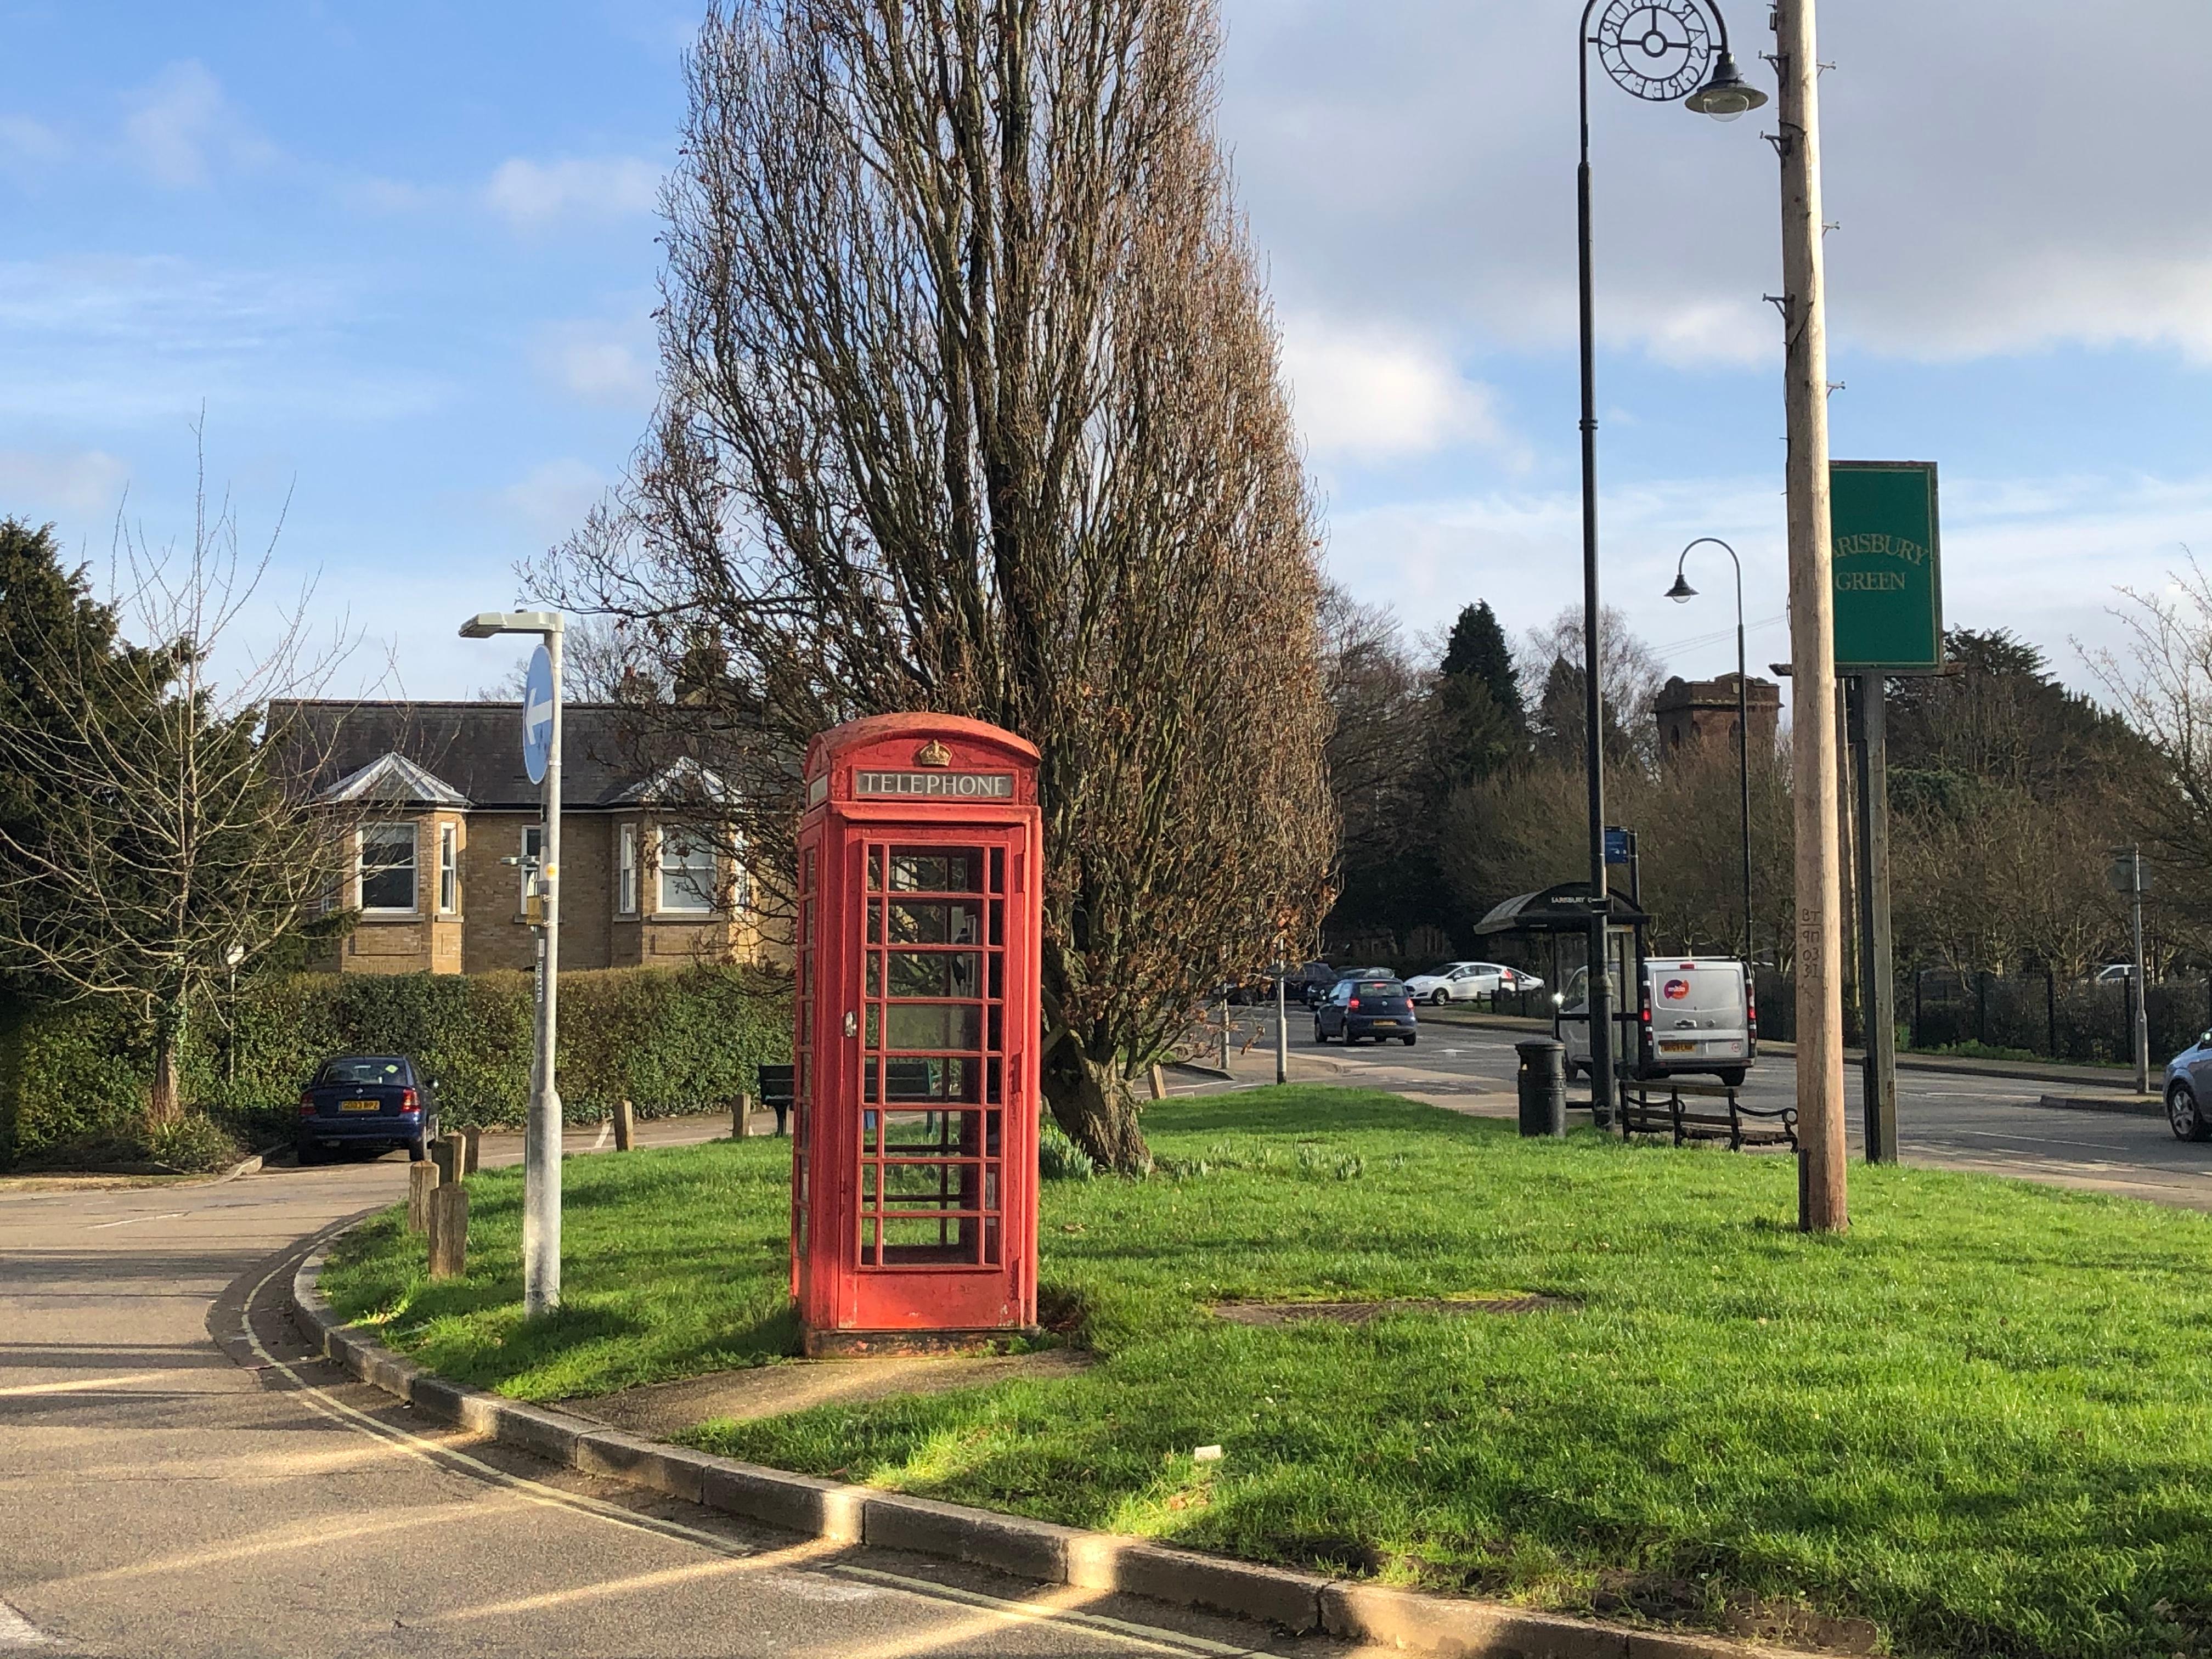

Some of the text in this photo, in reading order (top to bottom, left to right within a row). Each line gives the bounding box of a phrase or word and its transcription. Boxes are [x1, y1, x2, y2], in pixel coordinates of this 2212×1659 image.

[1835, 572, 1906, 591] GREEN
[863, 772, 1007, 796] TELEPHONE
[1802, 908, 1821, 921] BT
[1803, 947, 1819, 961] 03
